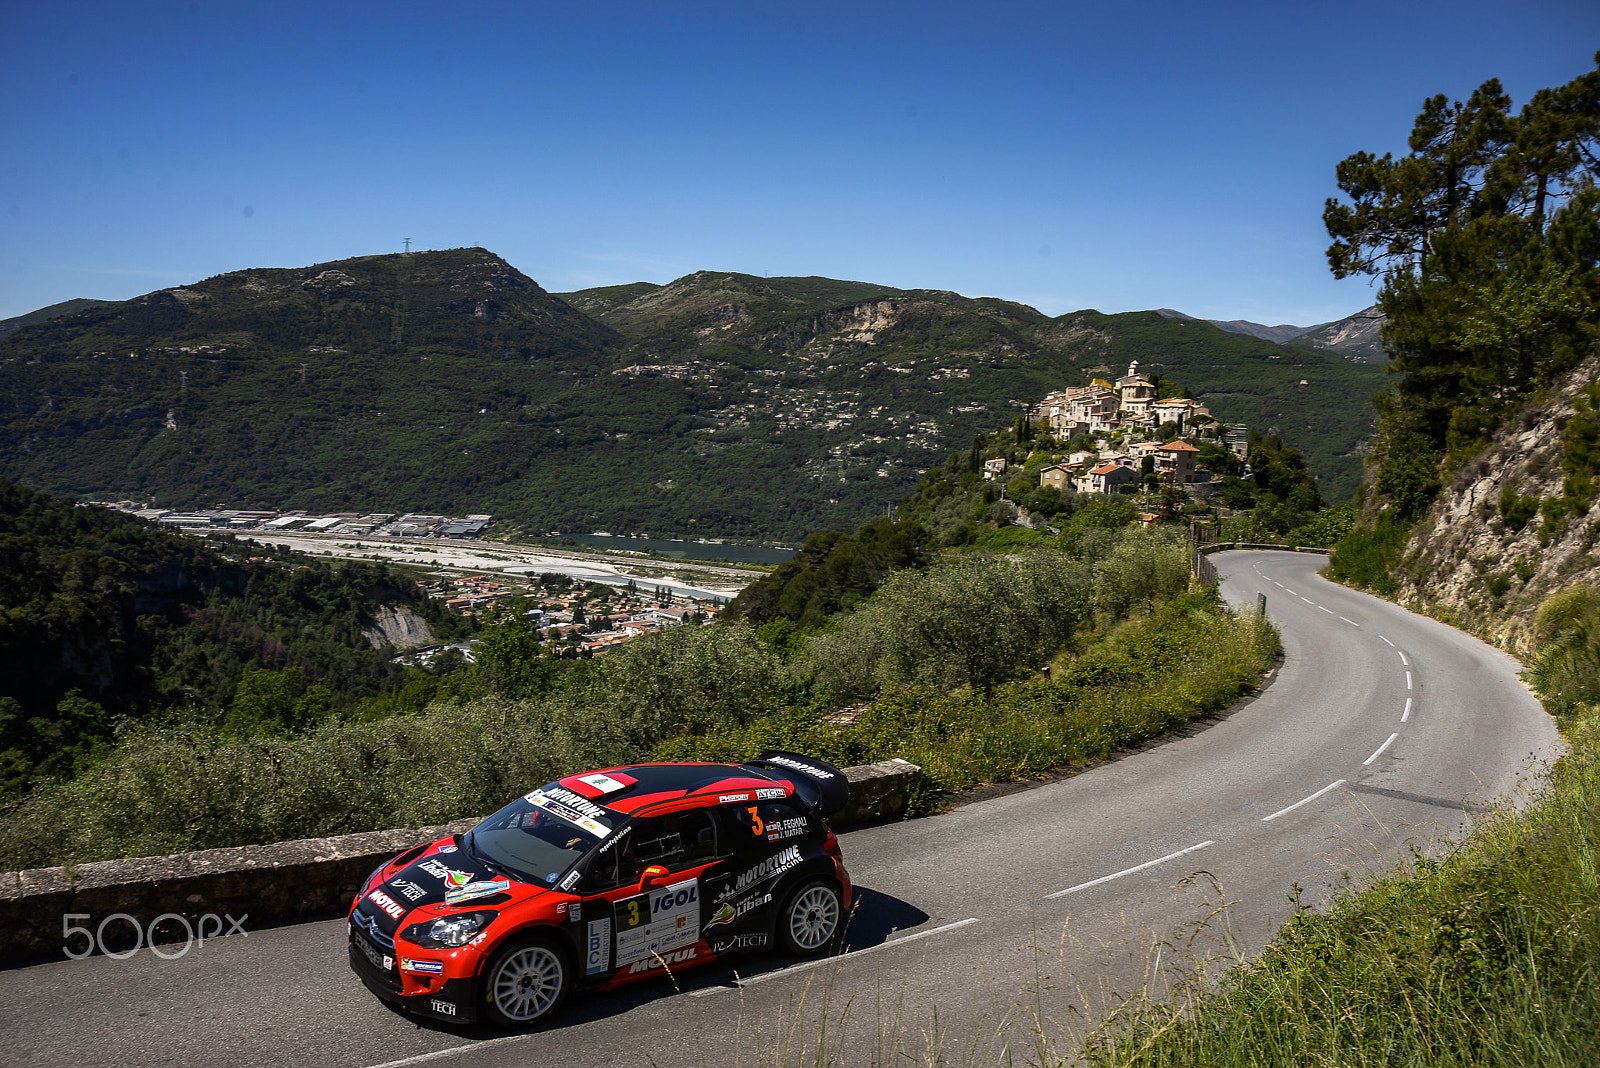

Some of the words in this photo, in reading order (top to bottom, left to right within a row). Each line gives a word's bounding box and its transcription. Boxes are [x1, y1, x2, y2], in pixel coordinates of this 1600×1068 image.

[543, 787, 606, 819] MOTORTUNE
[747, 806, 764, 836] 3
[783, 816, 808, 830] FEGHALI
[784, 827, 804, 838] MATAR
[735, 844, 800, 890] MOTORTUNE
[368, 890, 404, 919] MOTUL
[400, 886, 423, 902] TECH
[652, 886, 698, 914] IGOL
[627, 900, 640, 926] 3
[589, 923, 600, 965] LBC
[737, 936, 768, 948] TECH
[628, 947, 698, 975] MOTUL
[431, 1001, 456, 1016] TECH
